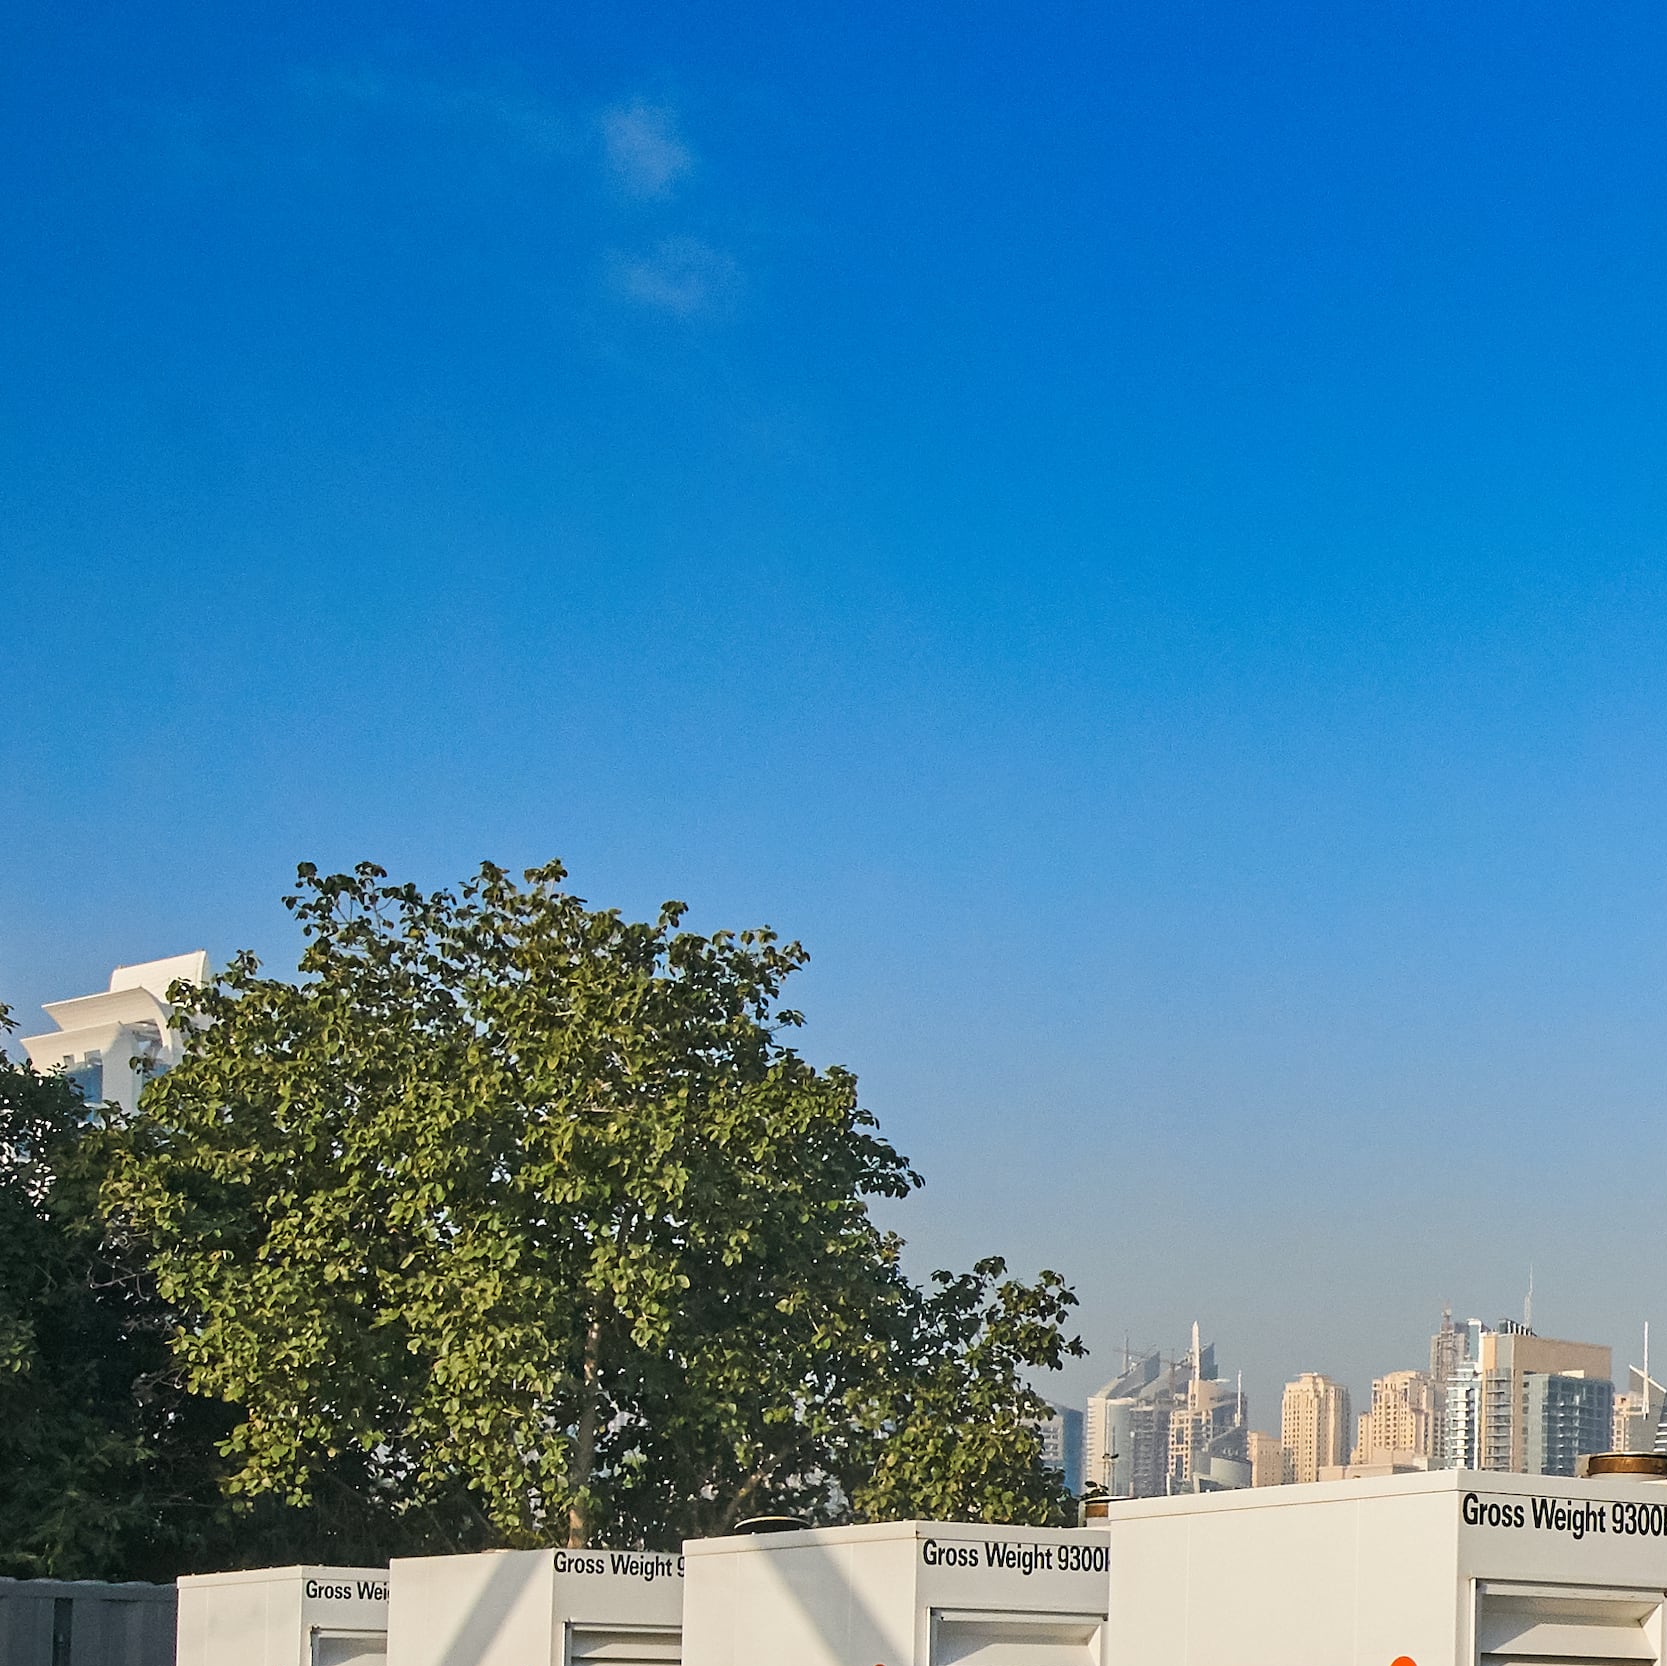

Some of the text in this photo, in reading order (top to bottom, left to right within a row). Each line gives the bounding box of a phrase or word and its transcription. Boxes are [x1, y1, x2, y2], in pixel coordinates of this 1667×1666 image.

[1463, 1492, 1524, 1528] Gross
[1531, 1498, 1606, 1540] Weight
[554, 1551, 605, 1574] Gross
[610, 1553, 672, 1581] Weight
[923, 1539, 978, 1566] Gross
[985, 1542, 1052, 1575] Weight
[306, 1580, 389, 1602] Gross Wei
